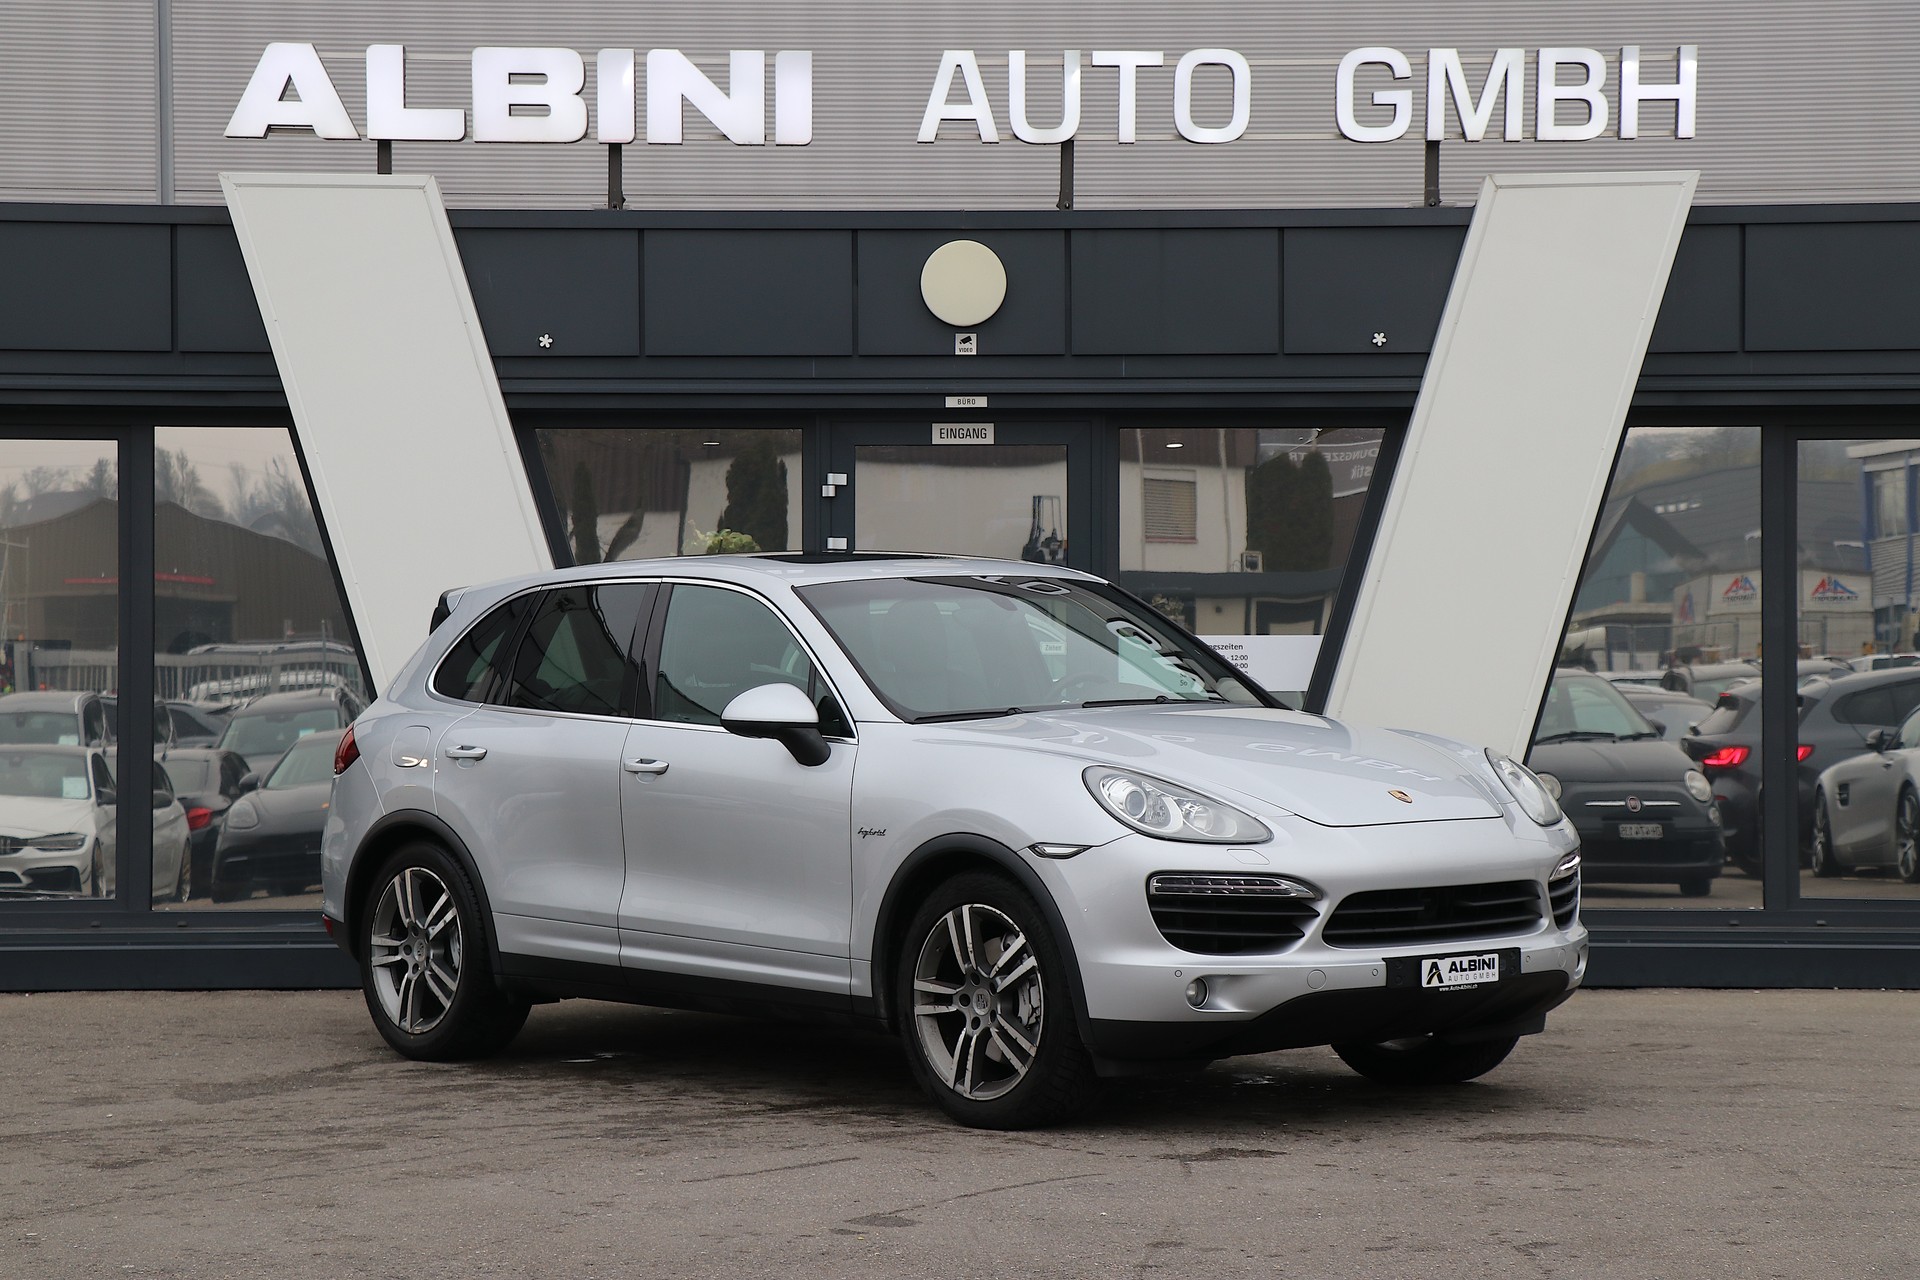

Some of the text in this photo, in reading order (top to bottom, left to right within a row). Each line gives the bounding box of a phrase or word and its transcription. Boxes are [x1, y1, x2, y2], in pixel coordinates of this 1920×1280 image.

[223, 41, 1698, 147] ALBINI AUTO GMBH
[939, 427, 987, 439] EINGANG
[858, 826, 886, 839] hybrid
[1448, 957, 1496, 974] ALBINI
[1448, 972, 1496, 982] AUTO GMBH
